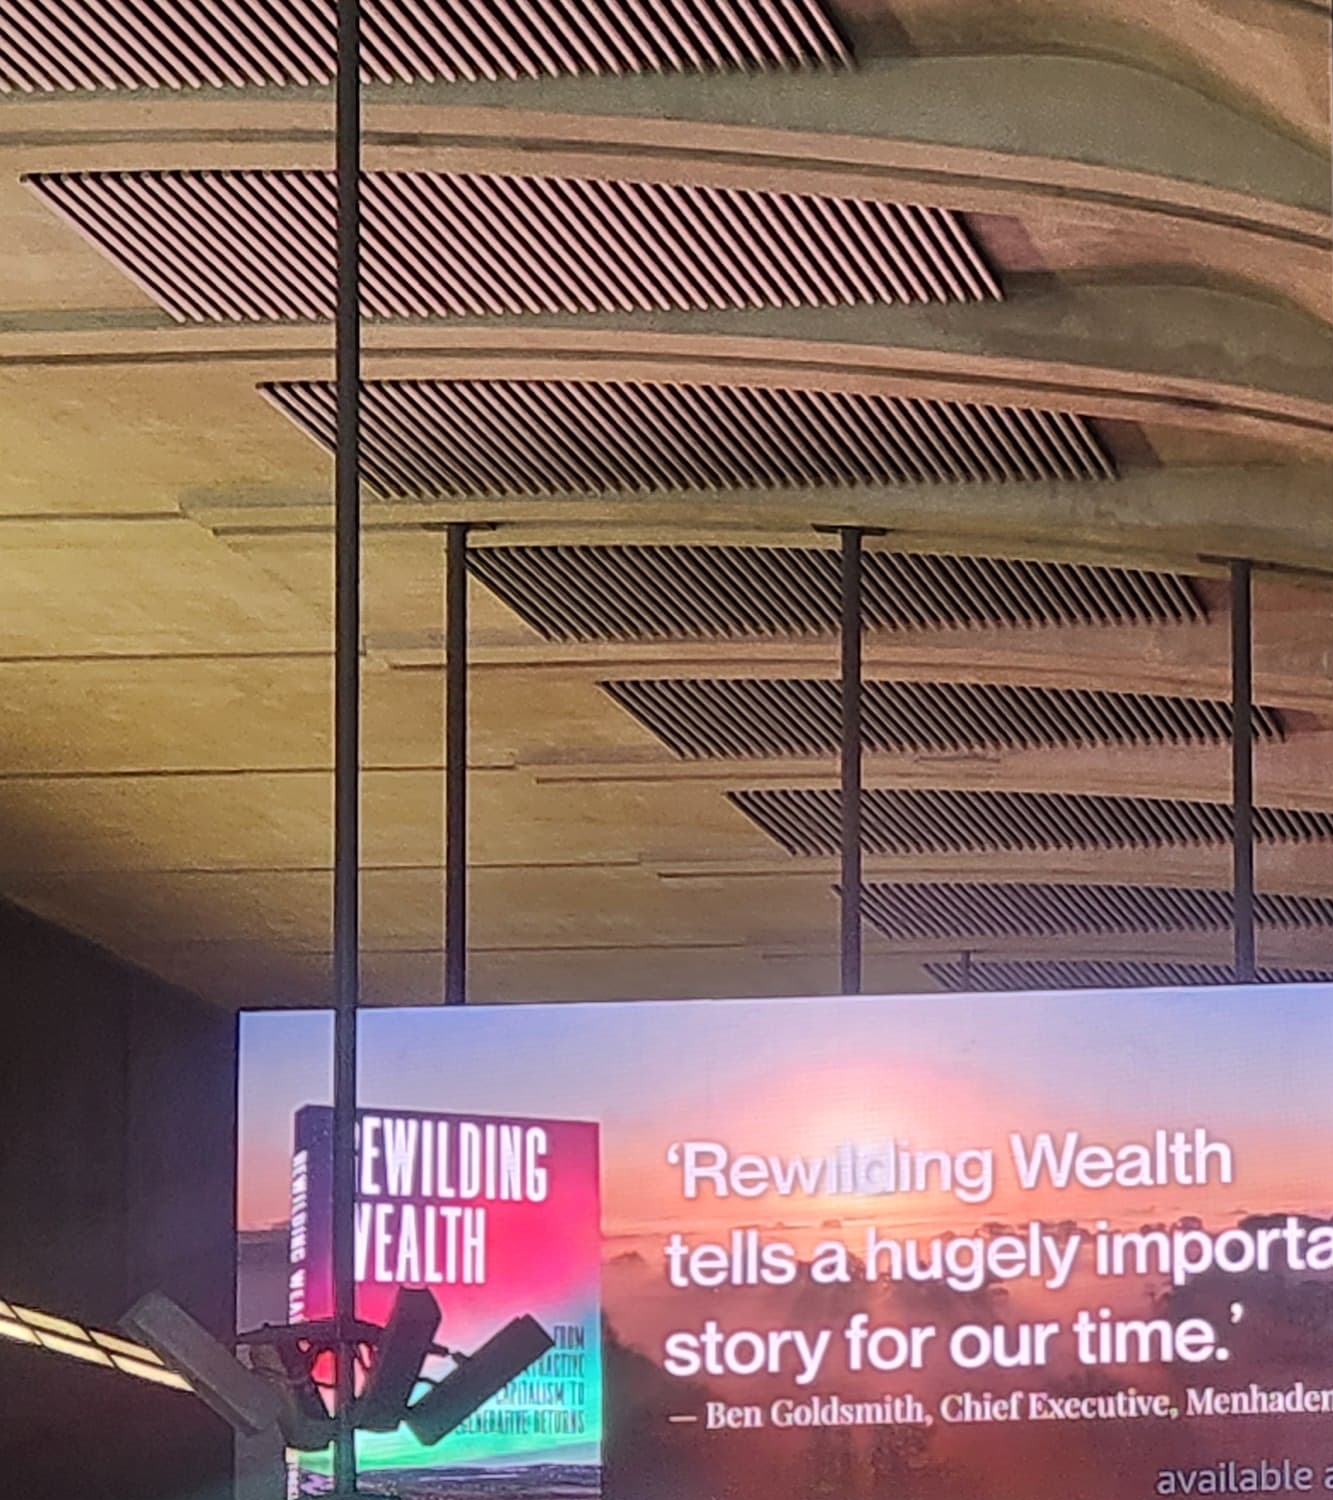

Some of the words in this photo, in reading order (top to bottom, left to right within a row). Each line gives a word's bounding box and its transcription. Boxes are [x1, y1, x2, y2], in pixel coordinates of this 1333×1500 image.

[354, 1115, 548, 1203] EWILDING
[1011, 1128, 1233, 1190] Wealth
[666, 1229, 796, 1288] tells
[810, 1240, 851, 1284] a
[864, 1223, 1081, 1292] hugely
[664, 1318, 840, 1384] story
[846, 1312, 934, 1371] for
[950, 1322, 1059, 1369] our
[705, 1402, 764, 1431] Ben
[771, 1396, 933, 1431] Goldsmith,
[940, 1391, 1023, 1423] Chief
[1029, 1387, 1178, 1421] Executive,
[1157, 1459, 1313, 1496] available
